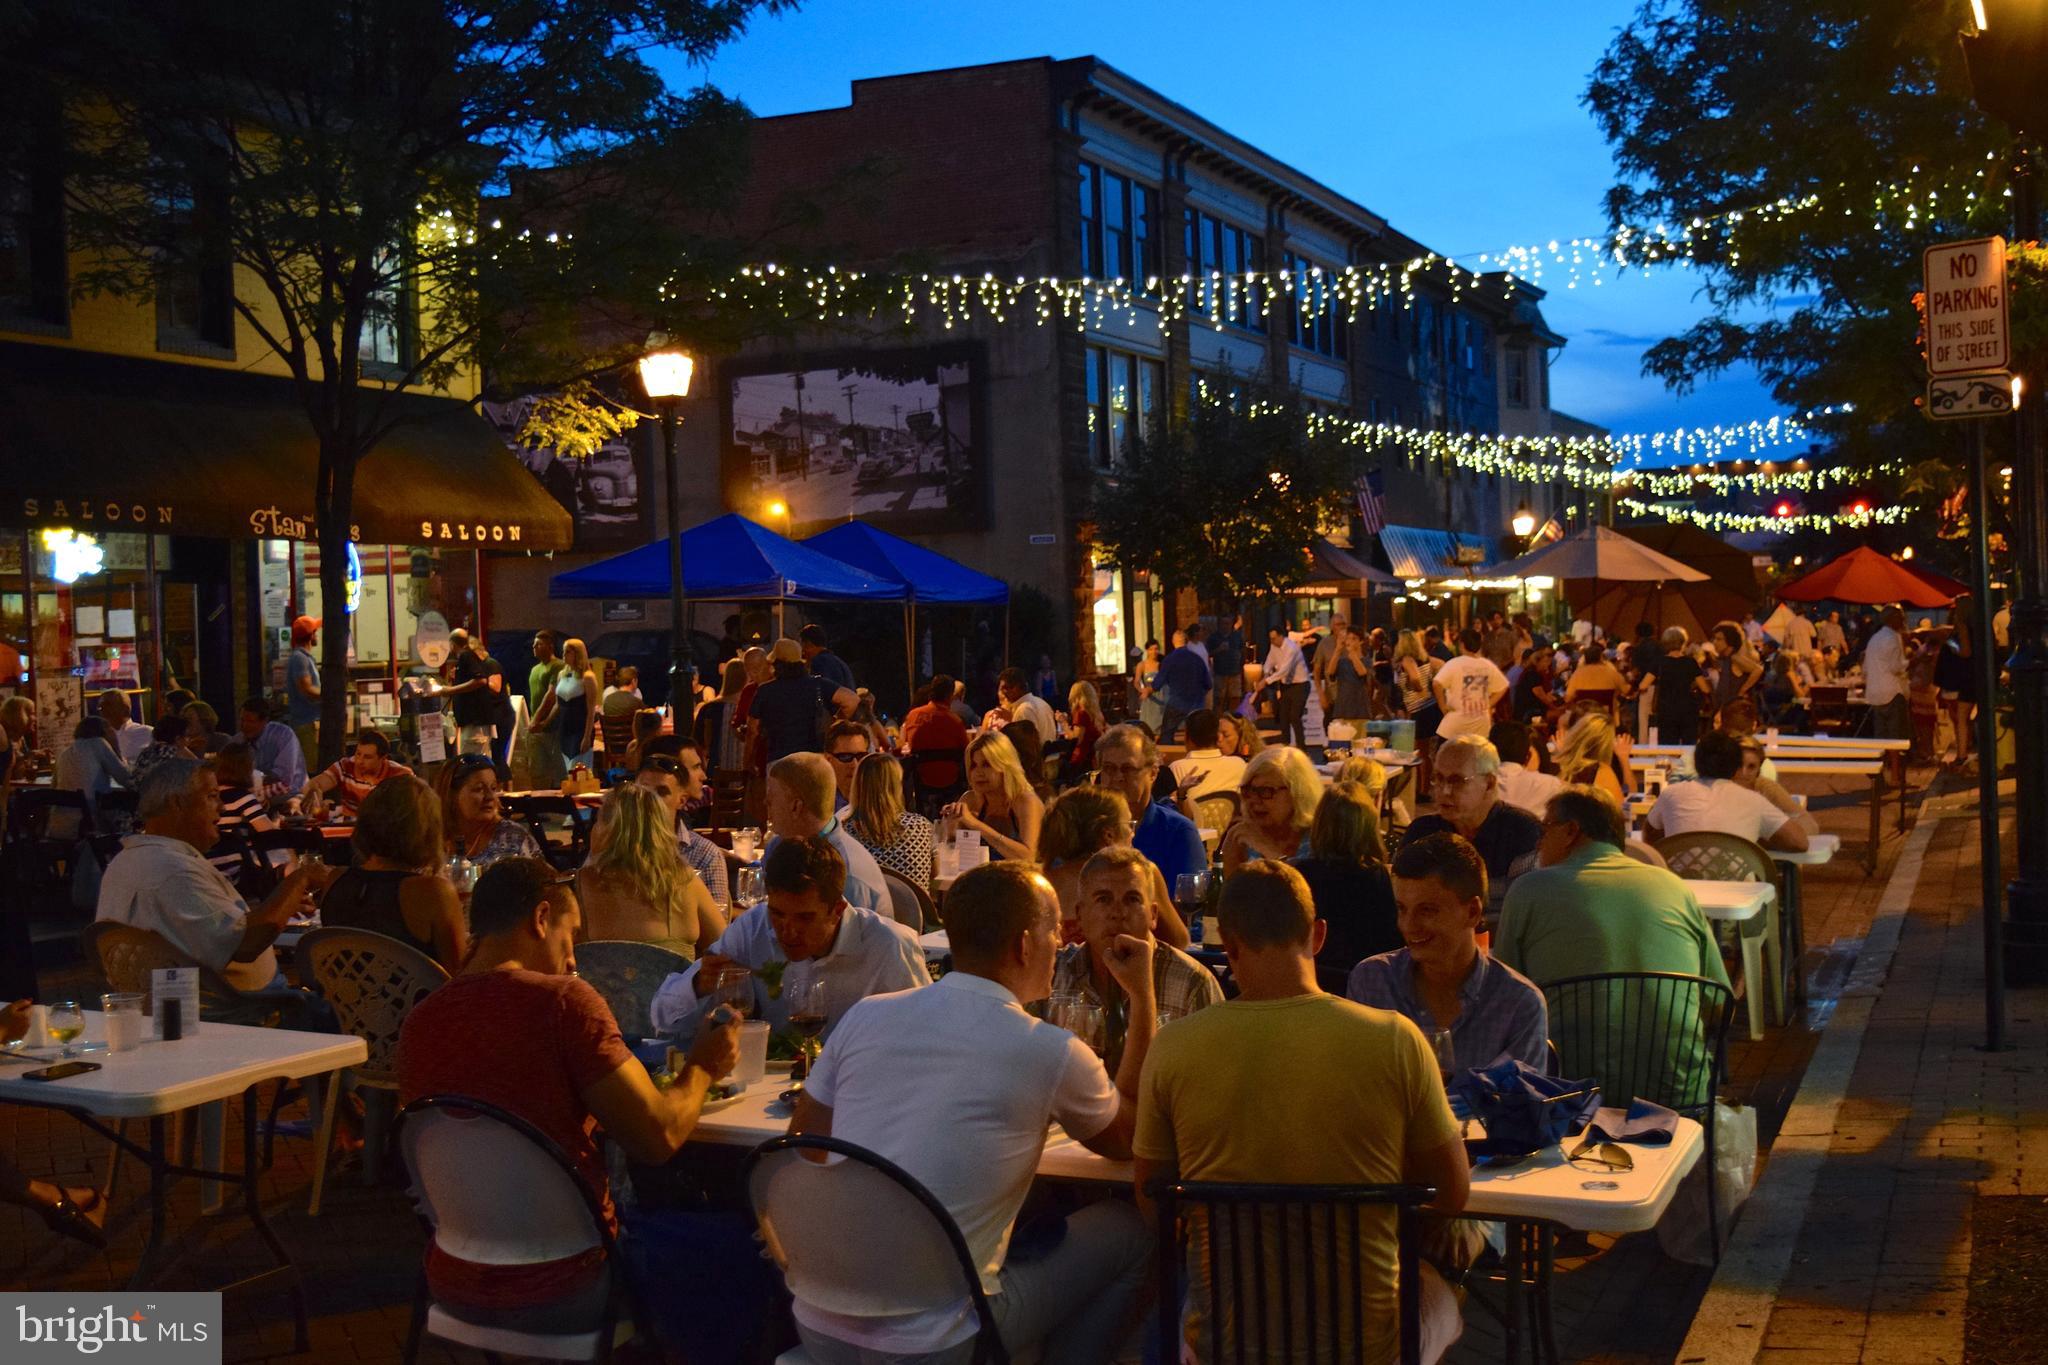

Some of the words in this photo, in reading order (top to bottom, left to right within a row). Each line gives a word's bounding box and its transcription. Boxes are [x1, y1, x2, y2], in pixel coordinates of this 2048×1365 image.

[1950, 253, 1977, 280] NO
[1934, 285, 1998, 315] PARKING
[1938, 322, 1963, 341] THIS
[1970, 318, 1996, 337] SIDE
[1936, 345, 1952, 362] OF
[1957, 340, 1999, 362] STREET
[24, 498, 174, 524] SALOON
[249, 505, 307, 540] Stan
[421, 520, 521, 542] SALOON
